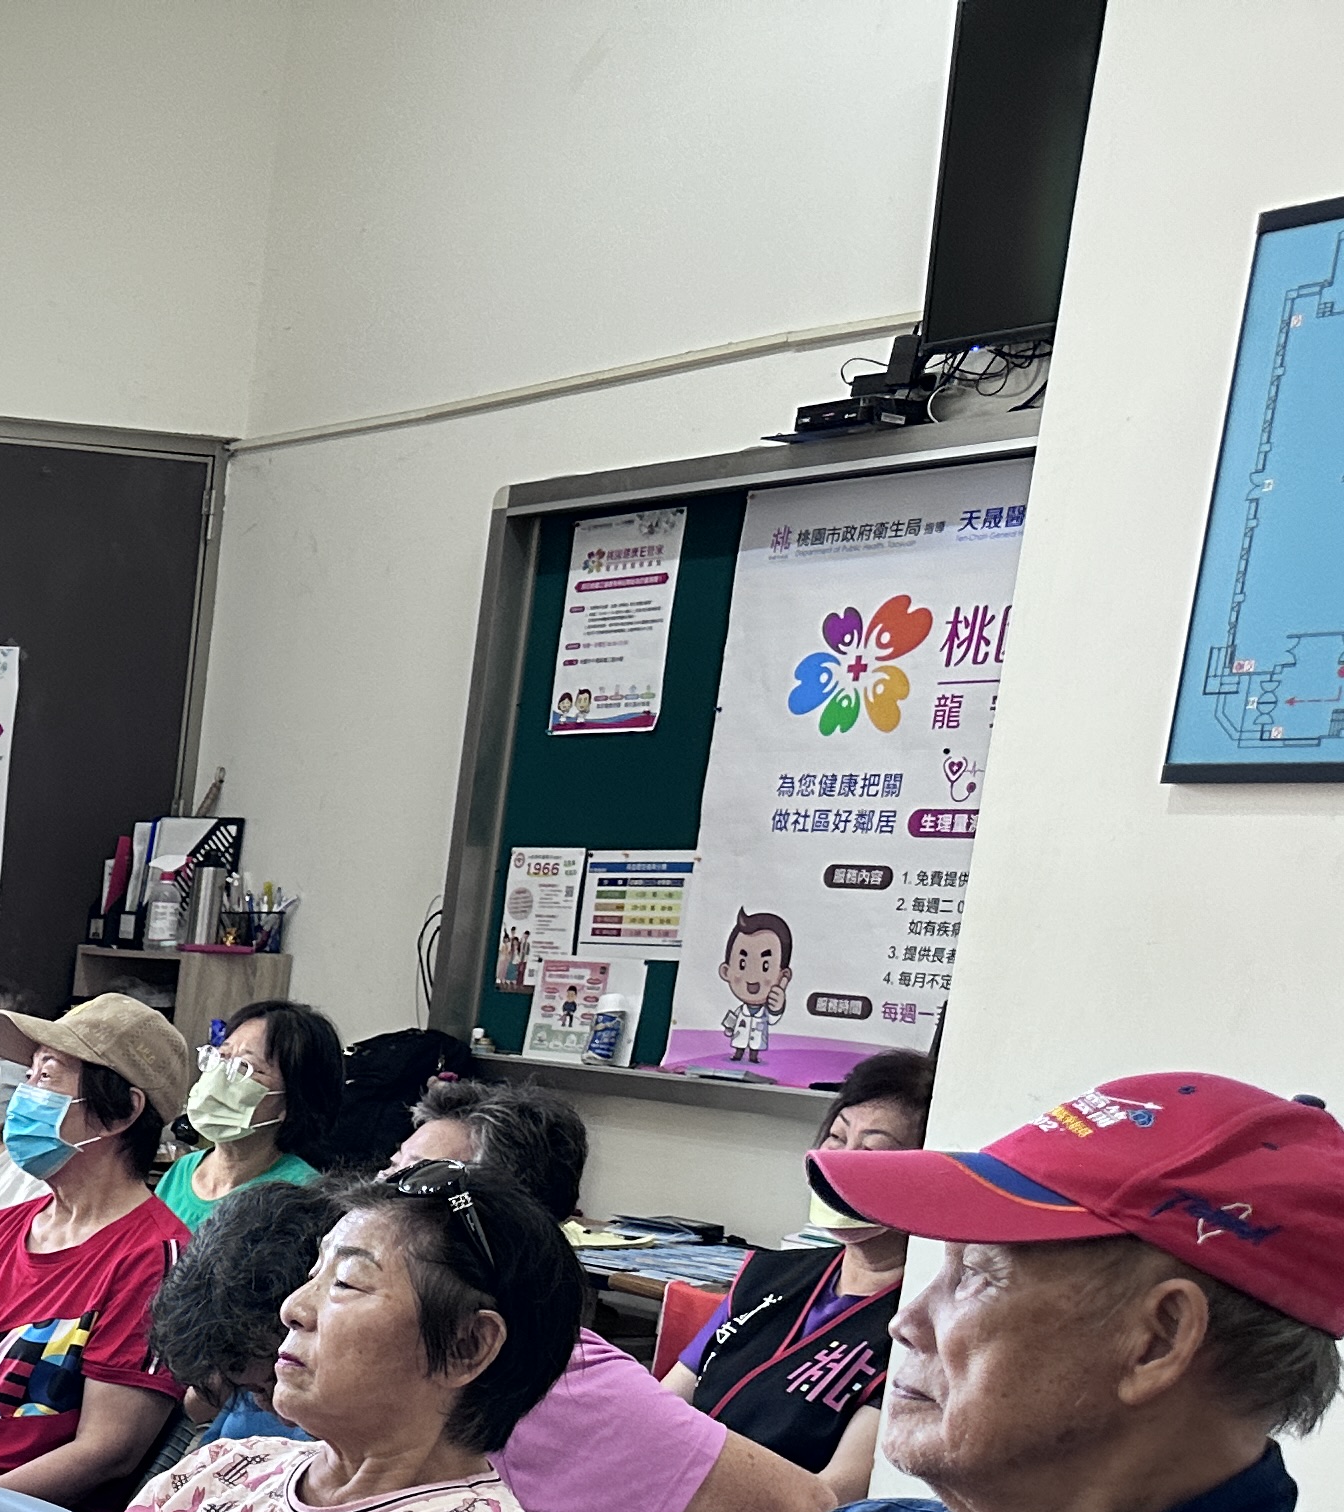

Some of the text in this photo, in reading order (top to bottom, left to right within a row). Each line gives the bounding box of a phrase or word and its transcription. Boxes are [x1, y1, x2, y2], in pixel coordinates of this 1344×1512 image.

[796, 517, 923, 548] 桃園市政府衛生局
[924, 520, 946, 534] 指導
[940, 604, 1012, 667] 桃
[776, 773, 904, 798] 為您健康把關
[771, 809, 898, 834] 做社區好鄰居
[526, 862, 560, 876] 1966
[832, 868, 884, 885] 服務內容
[914, 870, 970, 888] 免費提供
[911, 897, 954, 914] 每週二
[898, 971, 952, 990] 每月不定
[815, 998, 863, 1016] 服務時間
